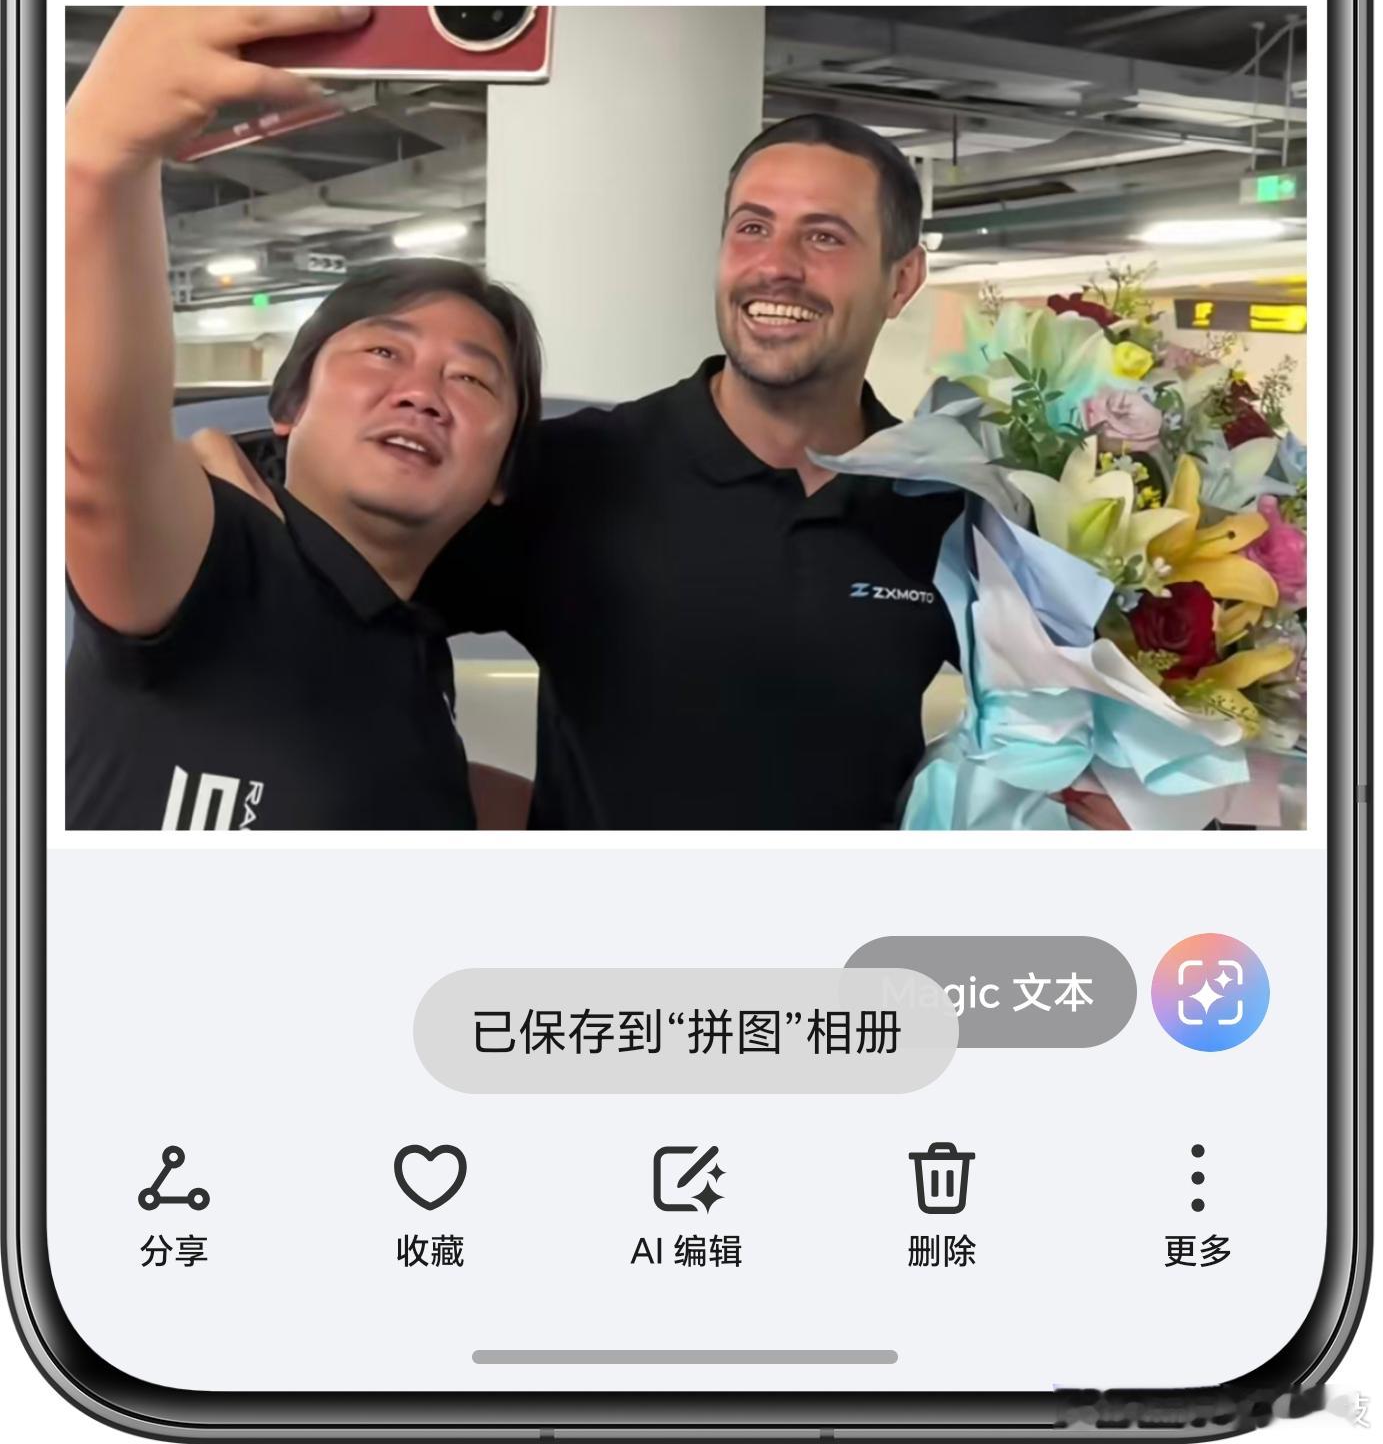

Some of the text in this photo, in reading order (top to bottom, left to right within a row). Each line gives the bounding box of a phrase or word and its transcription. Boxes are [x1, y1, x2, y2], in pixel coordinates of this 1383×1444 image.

[872, 586, 935, 605] ZXMOTO
[239, 780, 264, 830] RA
[1012, 971, 1094, 1013] 文本
[473, 1008, 902, 1055] 已保存到“拼图”相册
[140, 1233, 208, 1268] 分享
[396, 1233, 465, 1268] 收藏
[630, 1234, 742, 1268] AI 编辑
[908, 1233, 977, 1268] 删除
[1164, 1233, 1231, 1268] 更多
